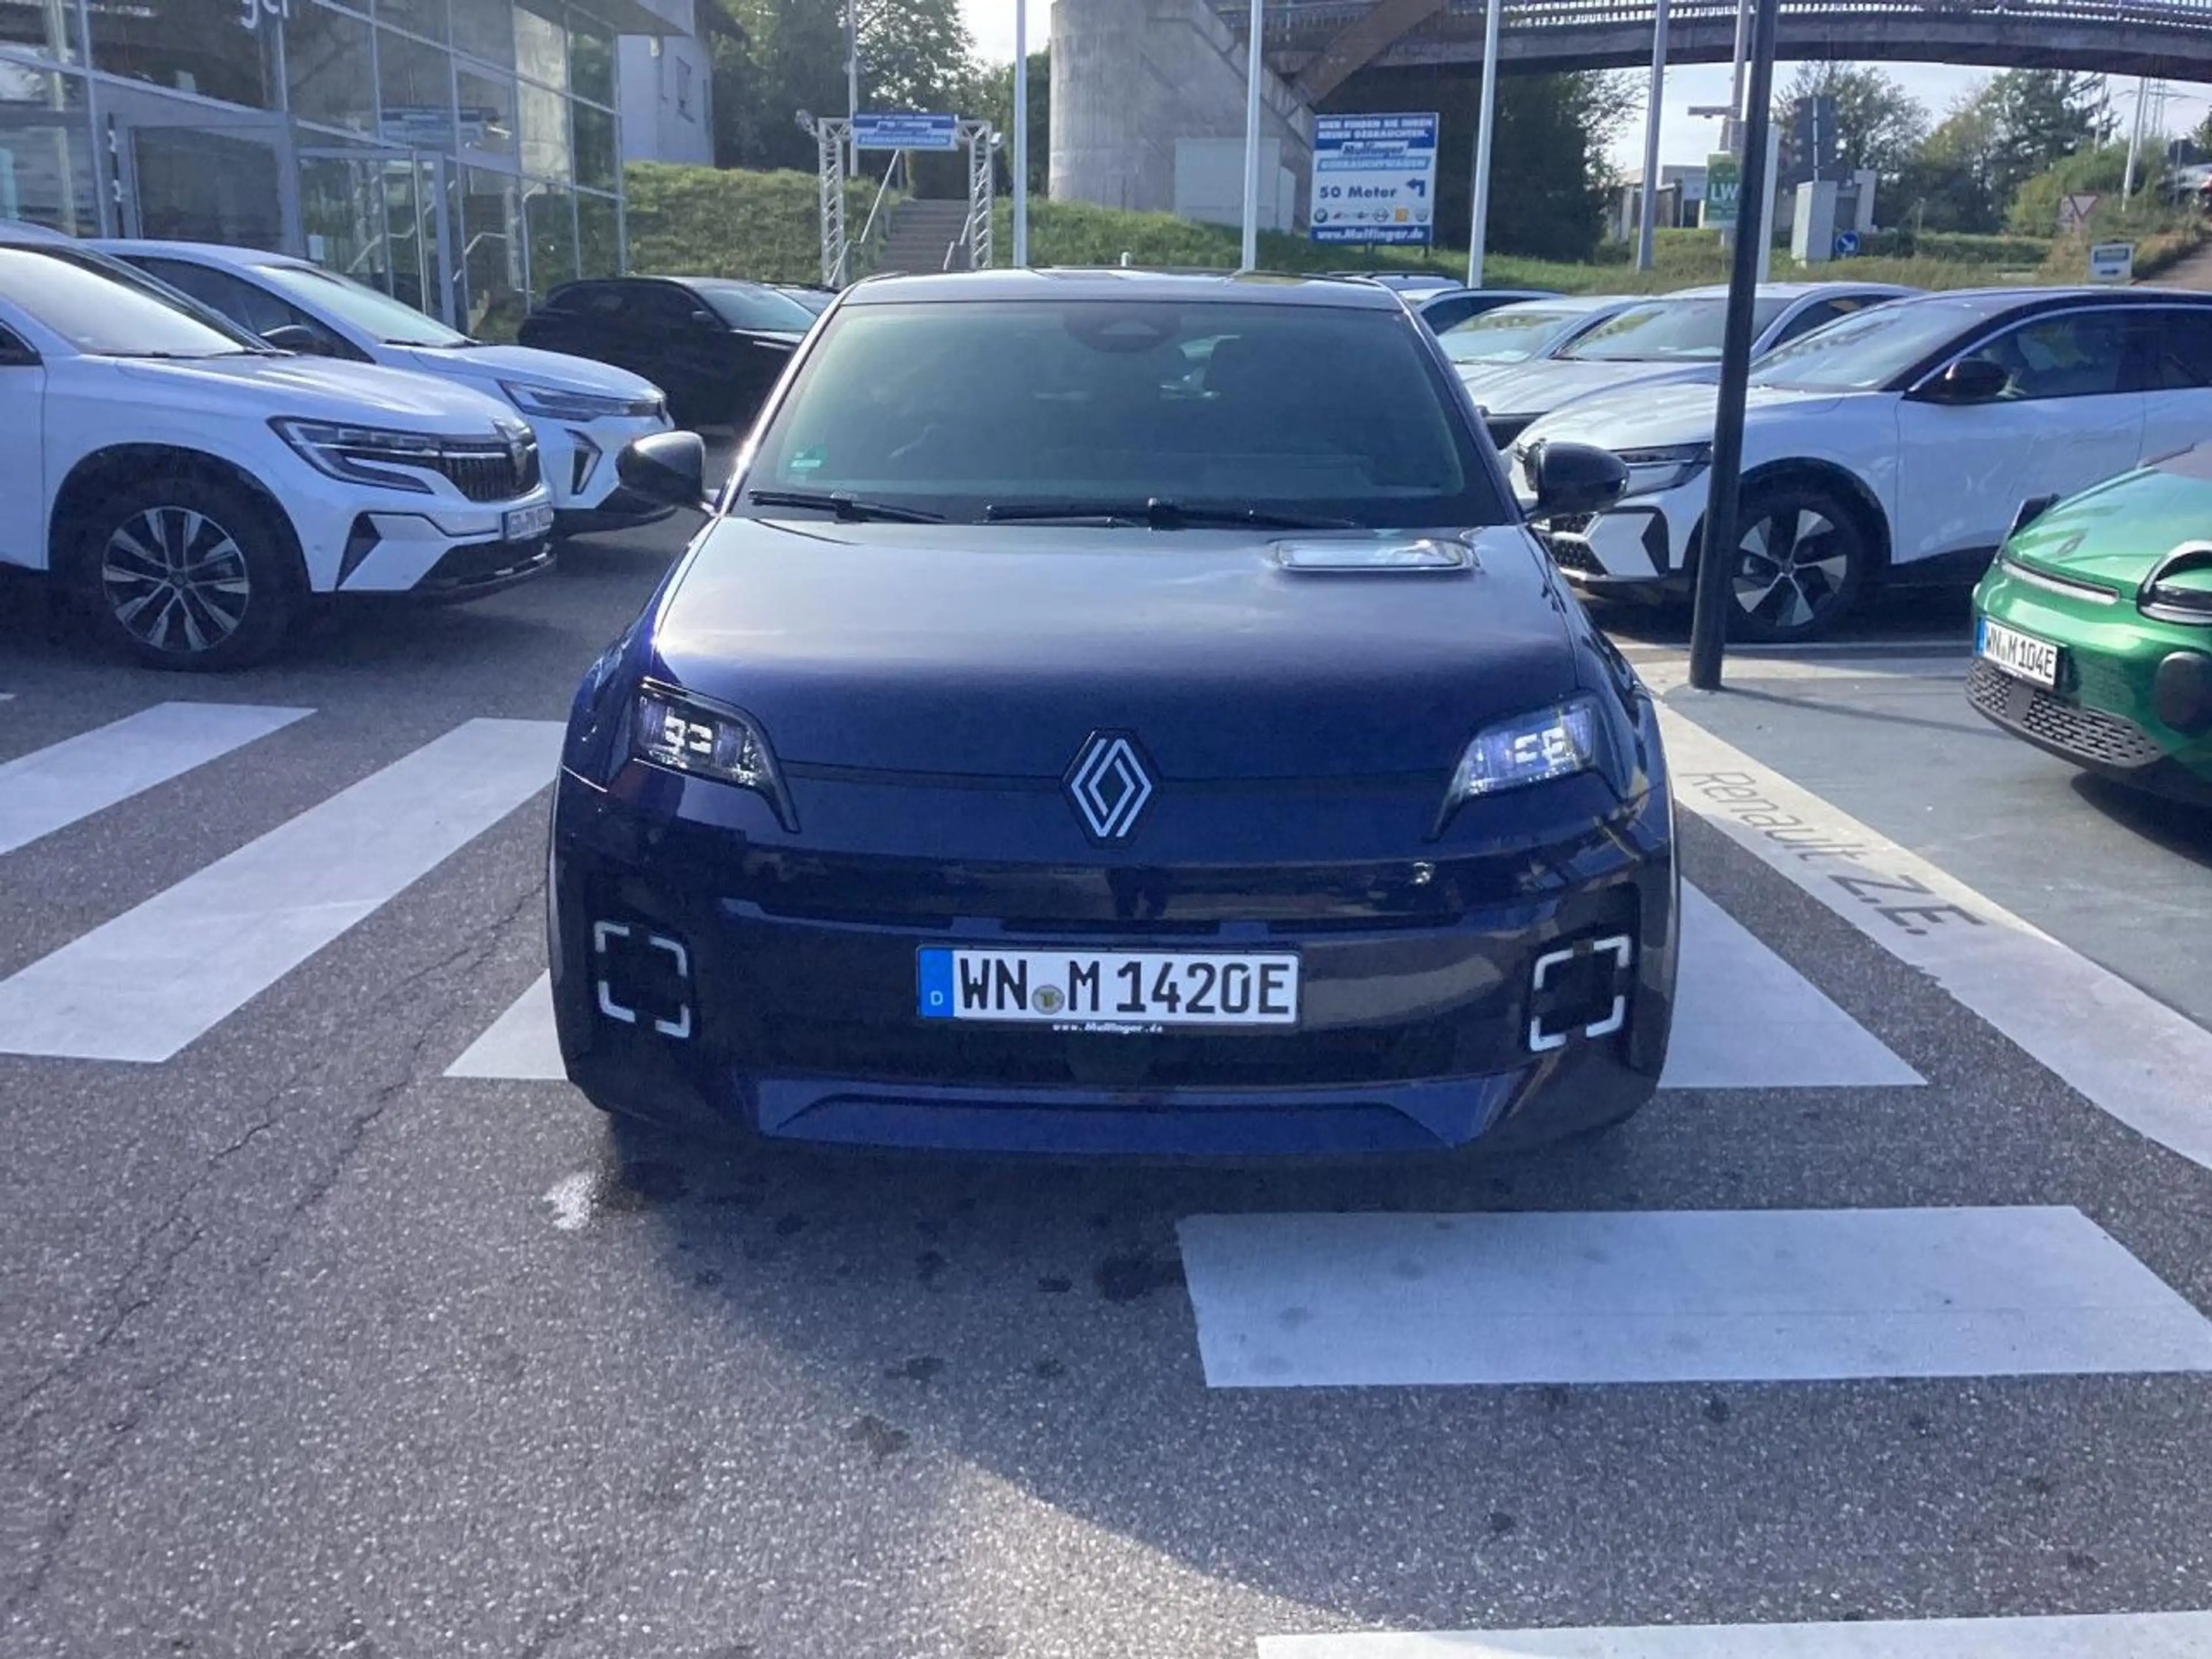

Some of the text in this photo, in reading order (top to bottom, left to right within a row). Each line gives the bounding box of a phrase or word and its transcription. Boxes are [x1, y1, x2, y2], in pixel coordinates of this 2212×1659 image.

[1319, 185, 1397, 199] 50 Meter
[2018, 639, 2054, 678] 104E
[1679, 772, 1868, 862] Renault
[930, 958, 1289, 1014] D WN M 1420E
